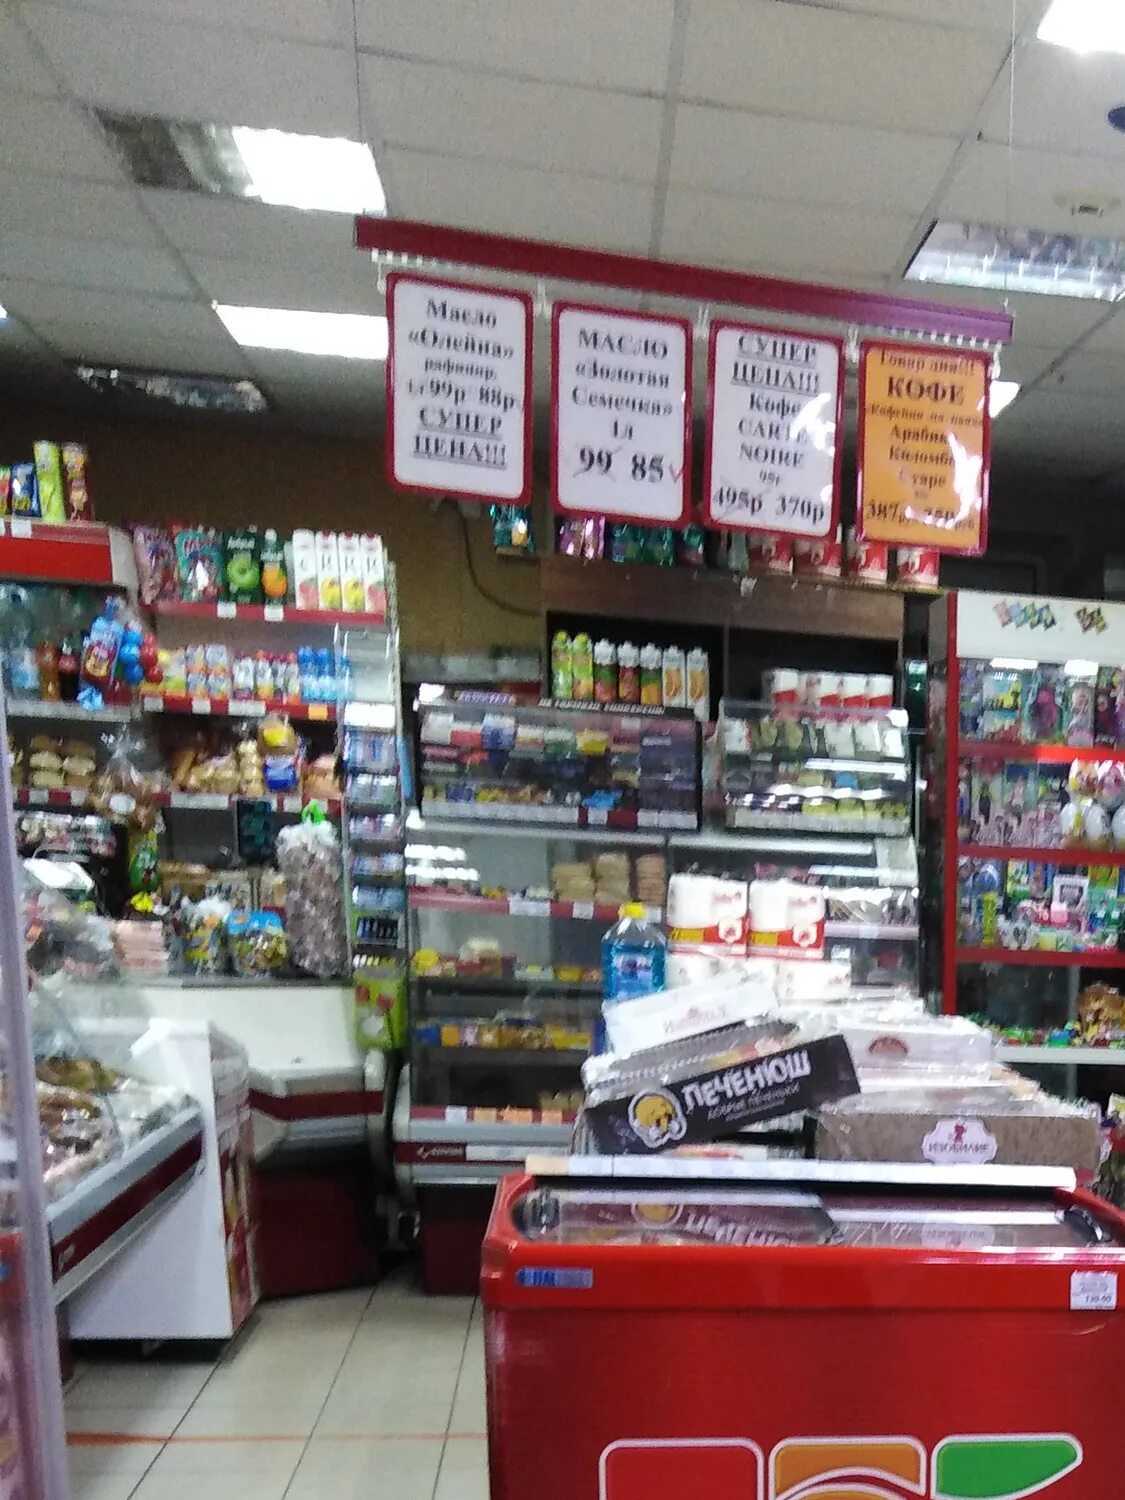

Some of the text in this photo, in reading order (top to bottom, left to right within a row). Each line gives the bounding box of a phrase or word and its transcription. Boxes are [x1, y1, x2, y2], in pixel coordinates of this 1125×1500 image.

[426, 298, 497, 328] Масло
[578, 328, 669, 360] МАСЛО
[738, 334, 817, 363] СУПЕР
[731, 361, 820, 394] ЦЕНА!!!
[886, 374, 966, 407] КОФЕ
[418, 405, 503, 435] СУПЕР
[613, 419, 634, 441] 1л
[415, 433, 507, 466] ЦЕНА!!!
[580, 445, 613, 475] 99
[680, 1049, 812, 1115] ПЕЧЕНЮШ
